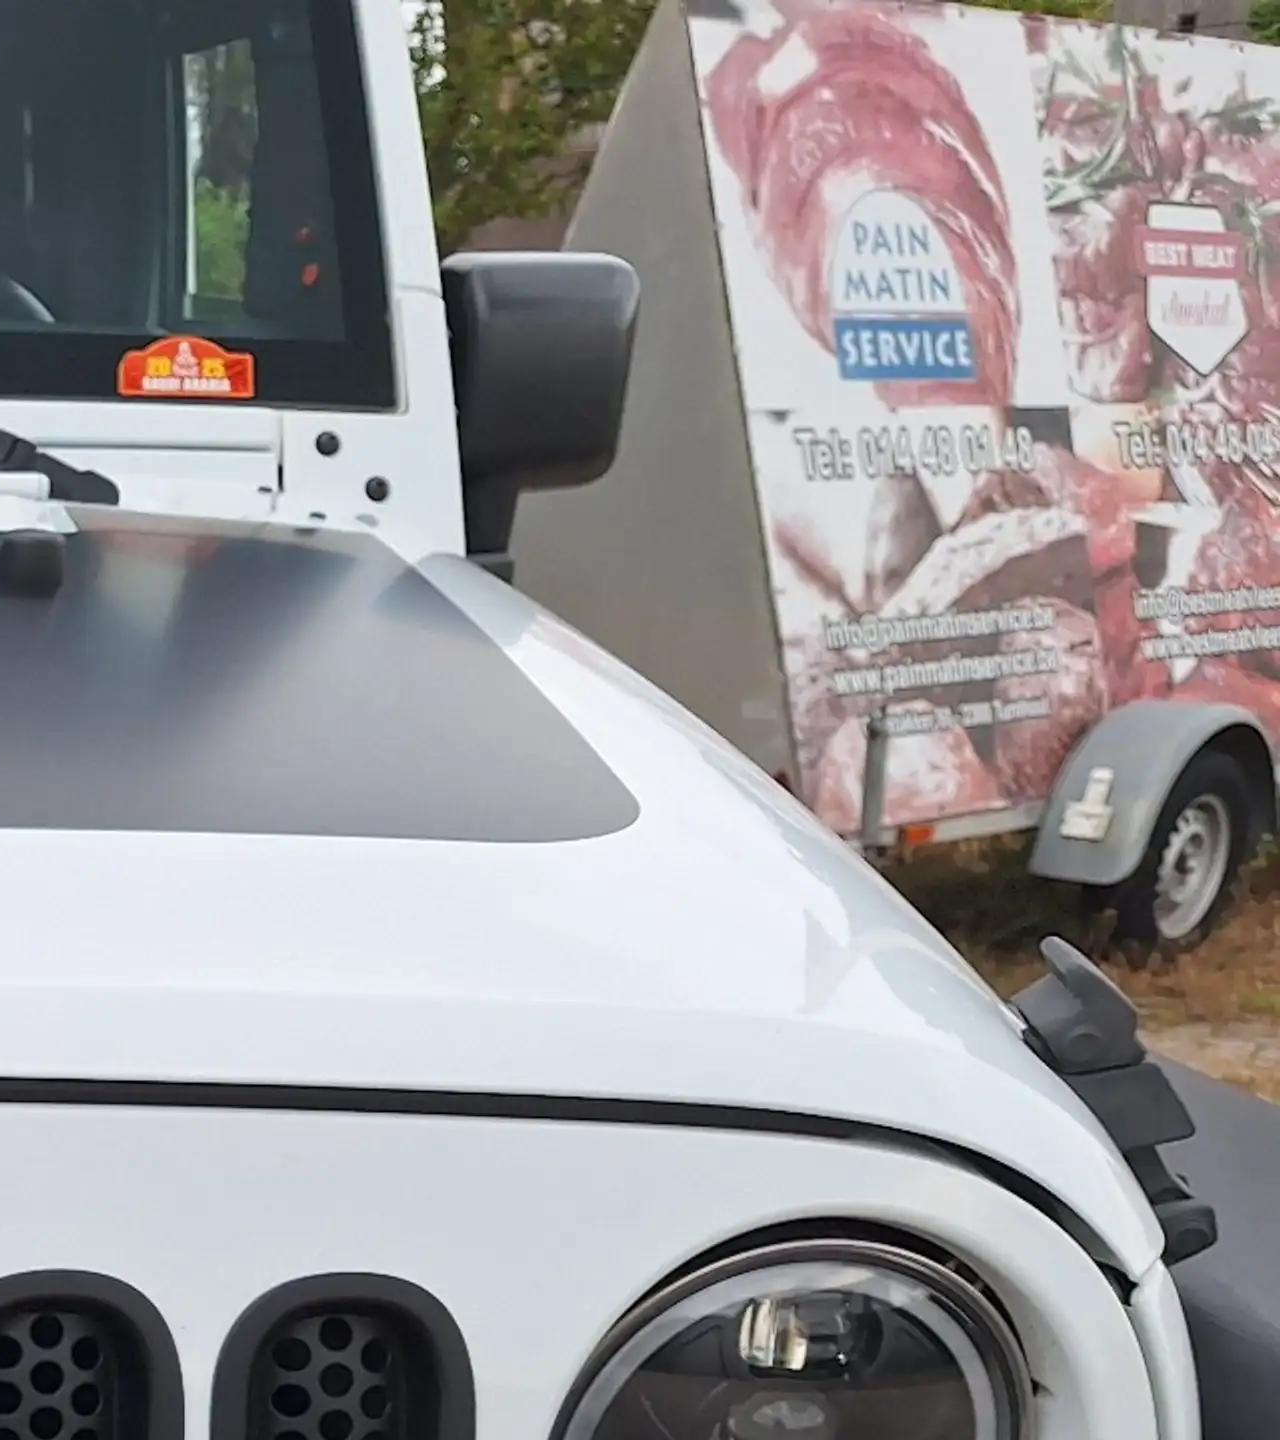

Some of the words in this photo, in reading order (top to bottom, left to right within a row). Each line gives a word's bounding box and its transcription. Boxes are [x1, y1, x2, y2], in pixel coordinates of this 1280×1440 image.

[852, 221, 930, 256] PAIN
[1143, 241, 1188, 266] BEST
[1190, 243, 1237, 268] MEAT
[844, 267, 951, 302] MATIN
[841, 329, 972, 367] SERVICE
[792, 426, 856, 481] Tel:
[857, 424, 916, 478] 014
[919, 424, 958, 477] 48
[1112, 420, 1163, 470] Tel:
